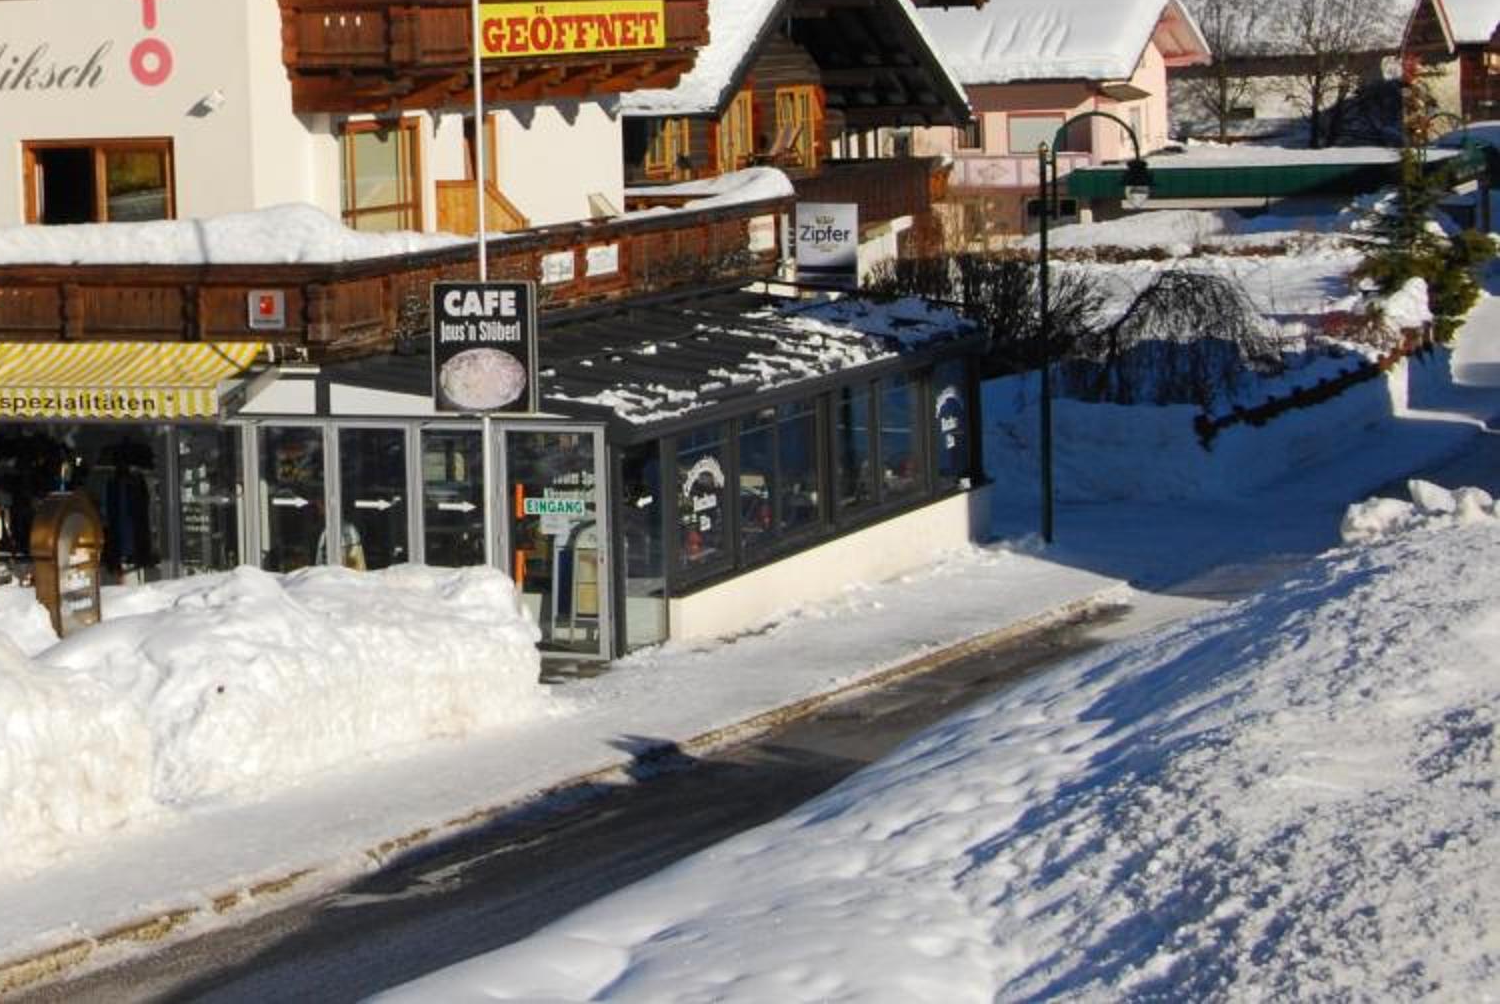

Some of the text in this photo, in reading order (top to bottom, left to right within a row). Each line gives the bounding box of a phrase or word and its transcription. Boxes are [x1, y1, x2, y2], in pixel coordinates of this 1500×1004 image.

[483, 6, 658, 53] GEÖFFNET
[800, 225, 850, 244] Zipfer
[444, 290, 516, 316] CAFE
[527, 500, 582, 512] EINGANG
